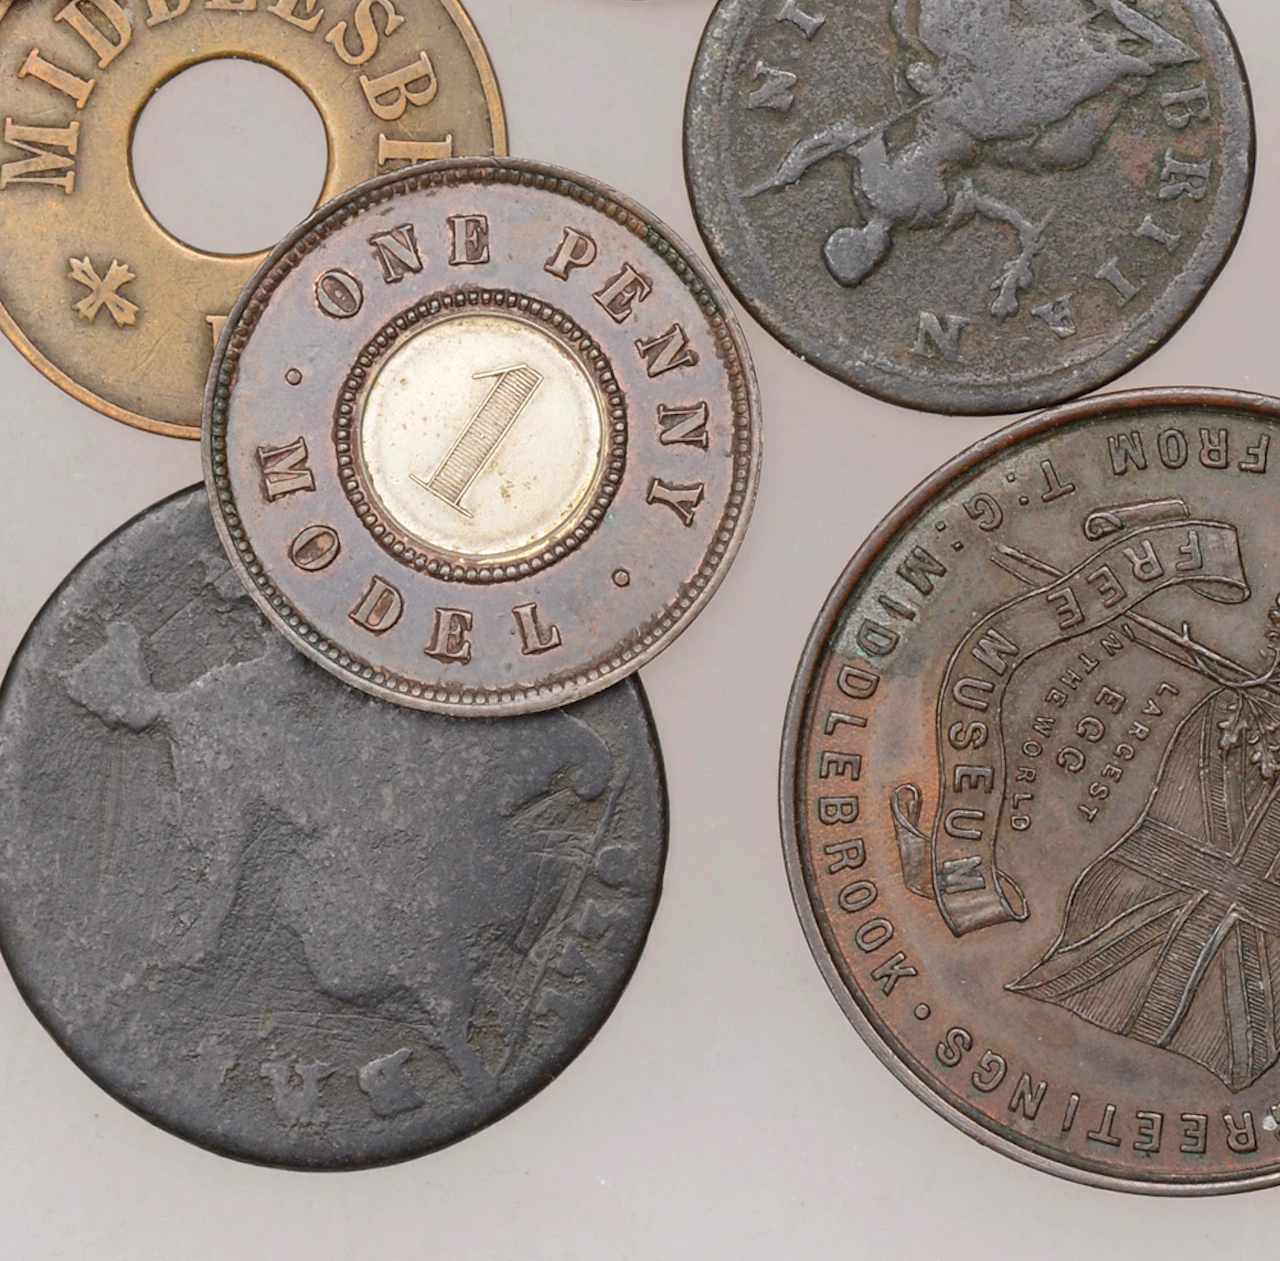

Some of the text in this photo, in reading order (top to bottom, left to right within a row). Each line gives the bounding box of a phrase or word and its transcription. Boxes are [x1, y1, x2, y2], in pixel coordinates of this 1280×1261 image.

[316, 213, 709, 527] ONE PENNY
[1109, 428, 1271, 478] FROM
[257, 436, 563, 664] MODEL
[819, 548, 948, 998] MIDDLEBROOK
[941, 529, 1206, 897] FREE MUSEUM
[1011, 716, 1055, 831] WORLD
[1080, 680, 1179, 823] LARGEST
